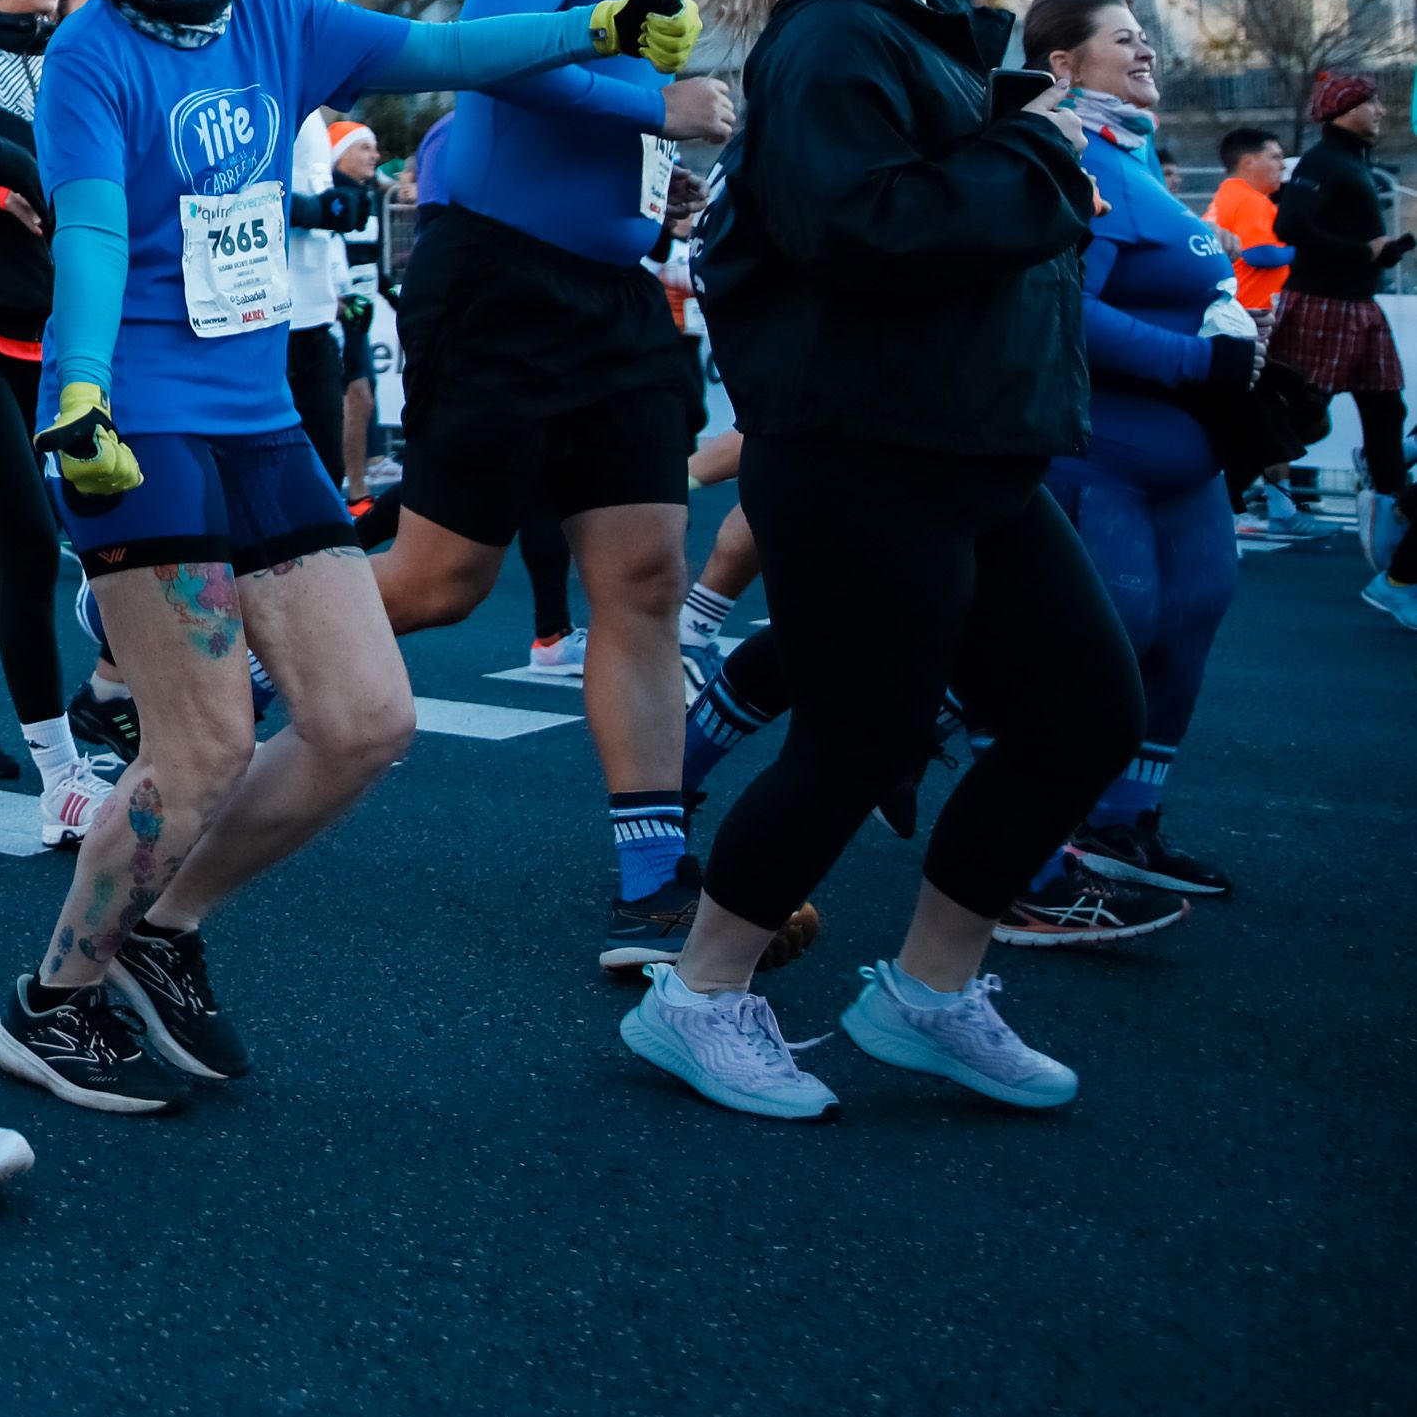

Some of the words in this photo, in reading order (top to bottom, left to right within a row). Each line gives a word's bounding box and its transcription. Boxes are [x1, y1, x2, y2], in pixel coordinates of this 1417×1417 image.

[193, 99, 254, 166] life
[203, 149, 257, 195] CARREFR
[208, 218, 269, 259] 7665
[236, 289, 267, 306] Sabadell
